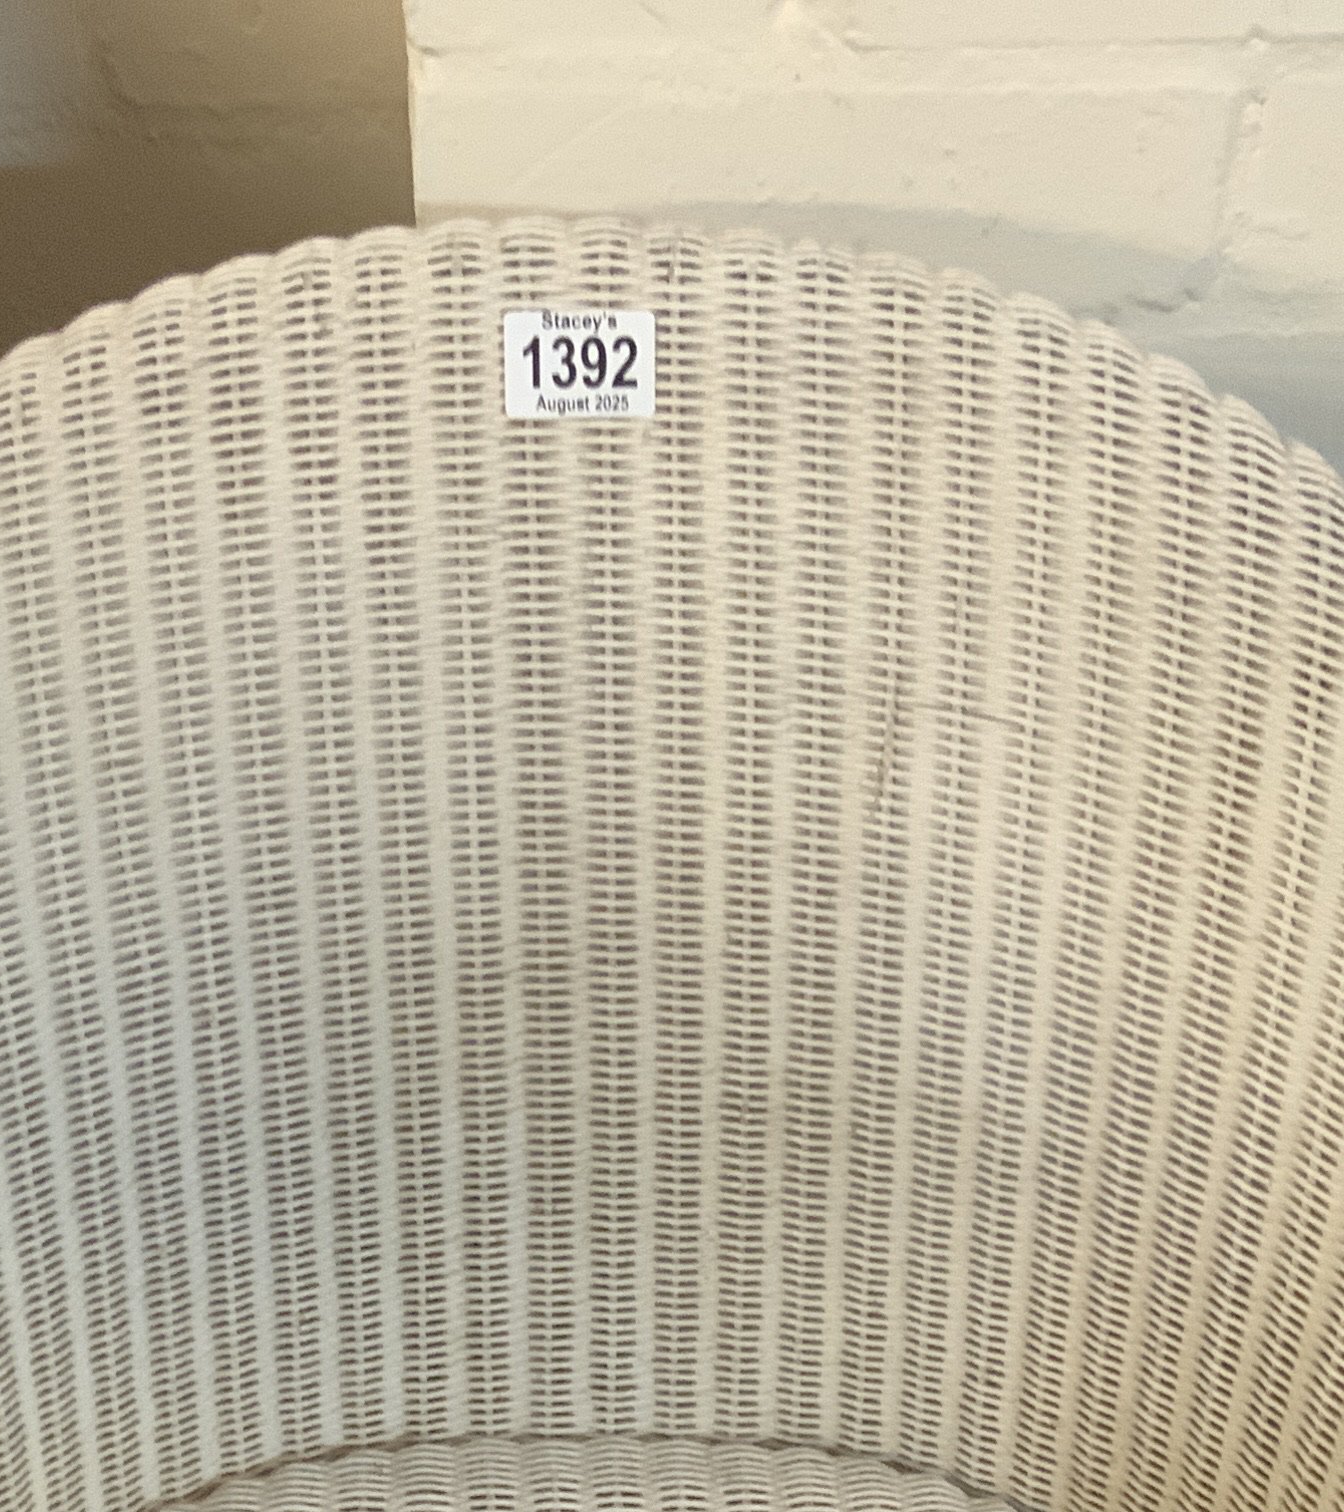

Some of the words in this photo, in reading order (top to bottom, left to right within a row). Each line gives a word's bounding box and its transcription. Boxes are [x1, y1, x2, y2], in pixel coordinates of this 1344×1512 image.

[542, 309, 616, 333] Stacey's
[522, 335, 638, 389] 1392
[537, 394, 589, 415] August
[595, 395, 629, 412] 2025
